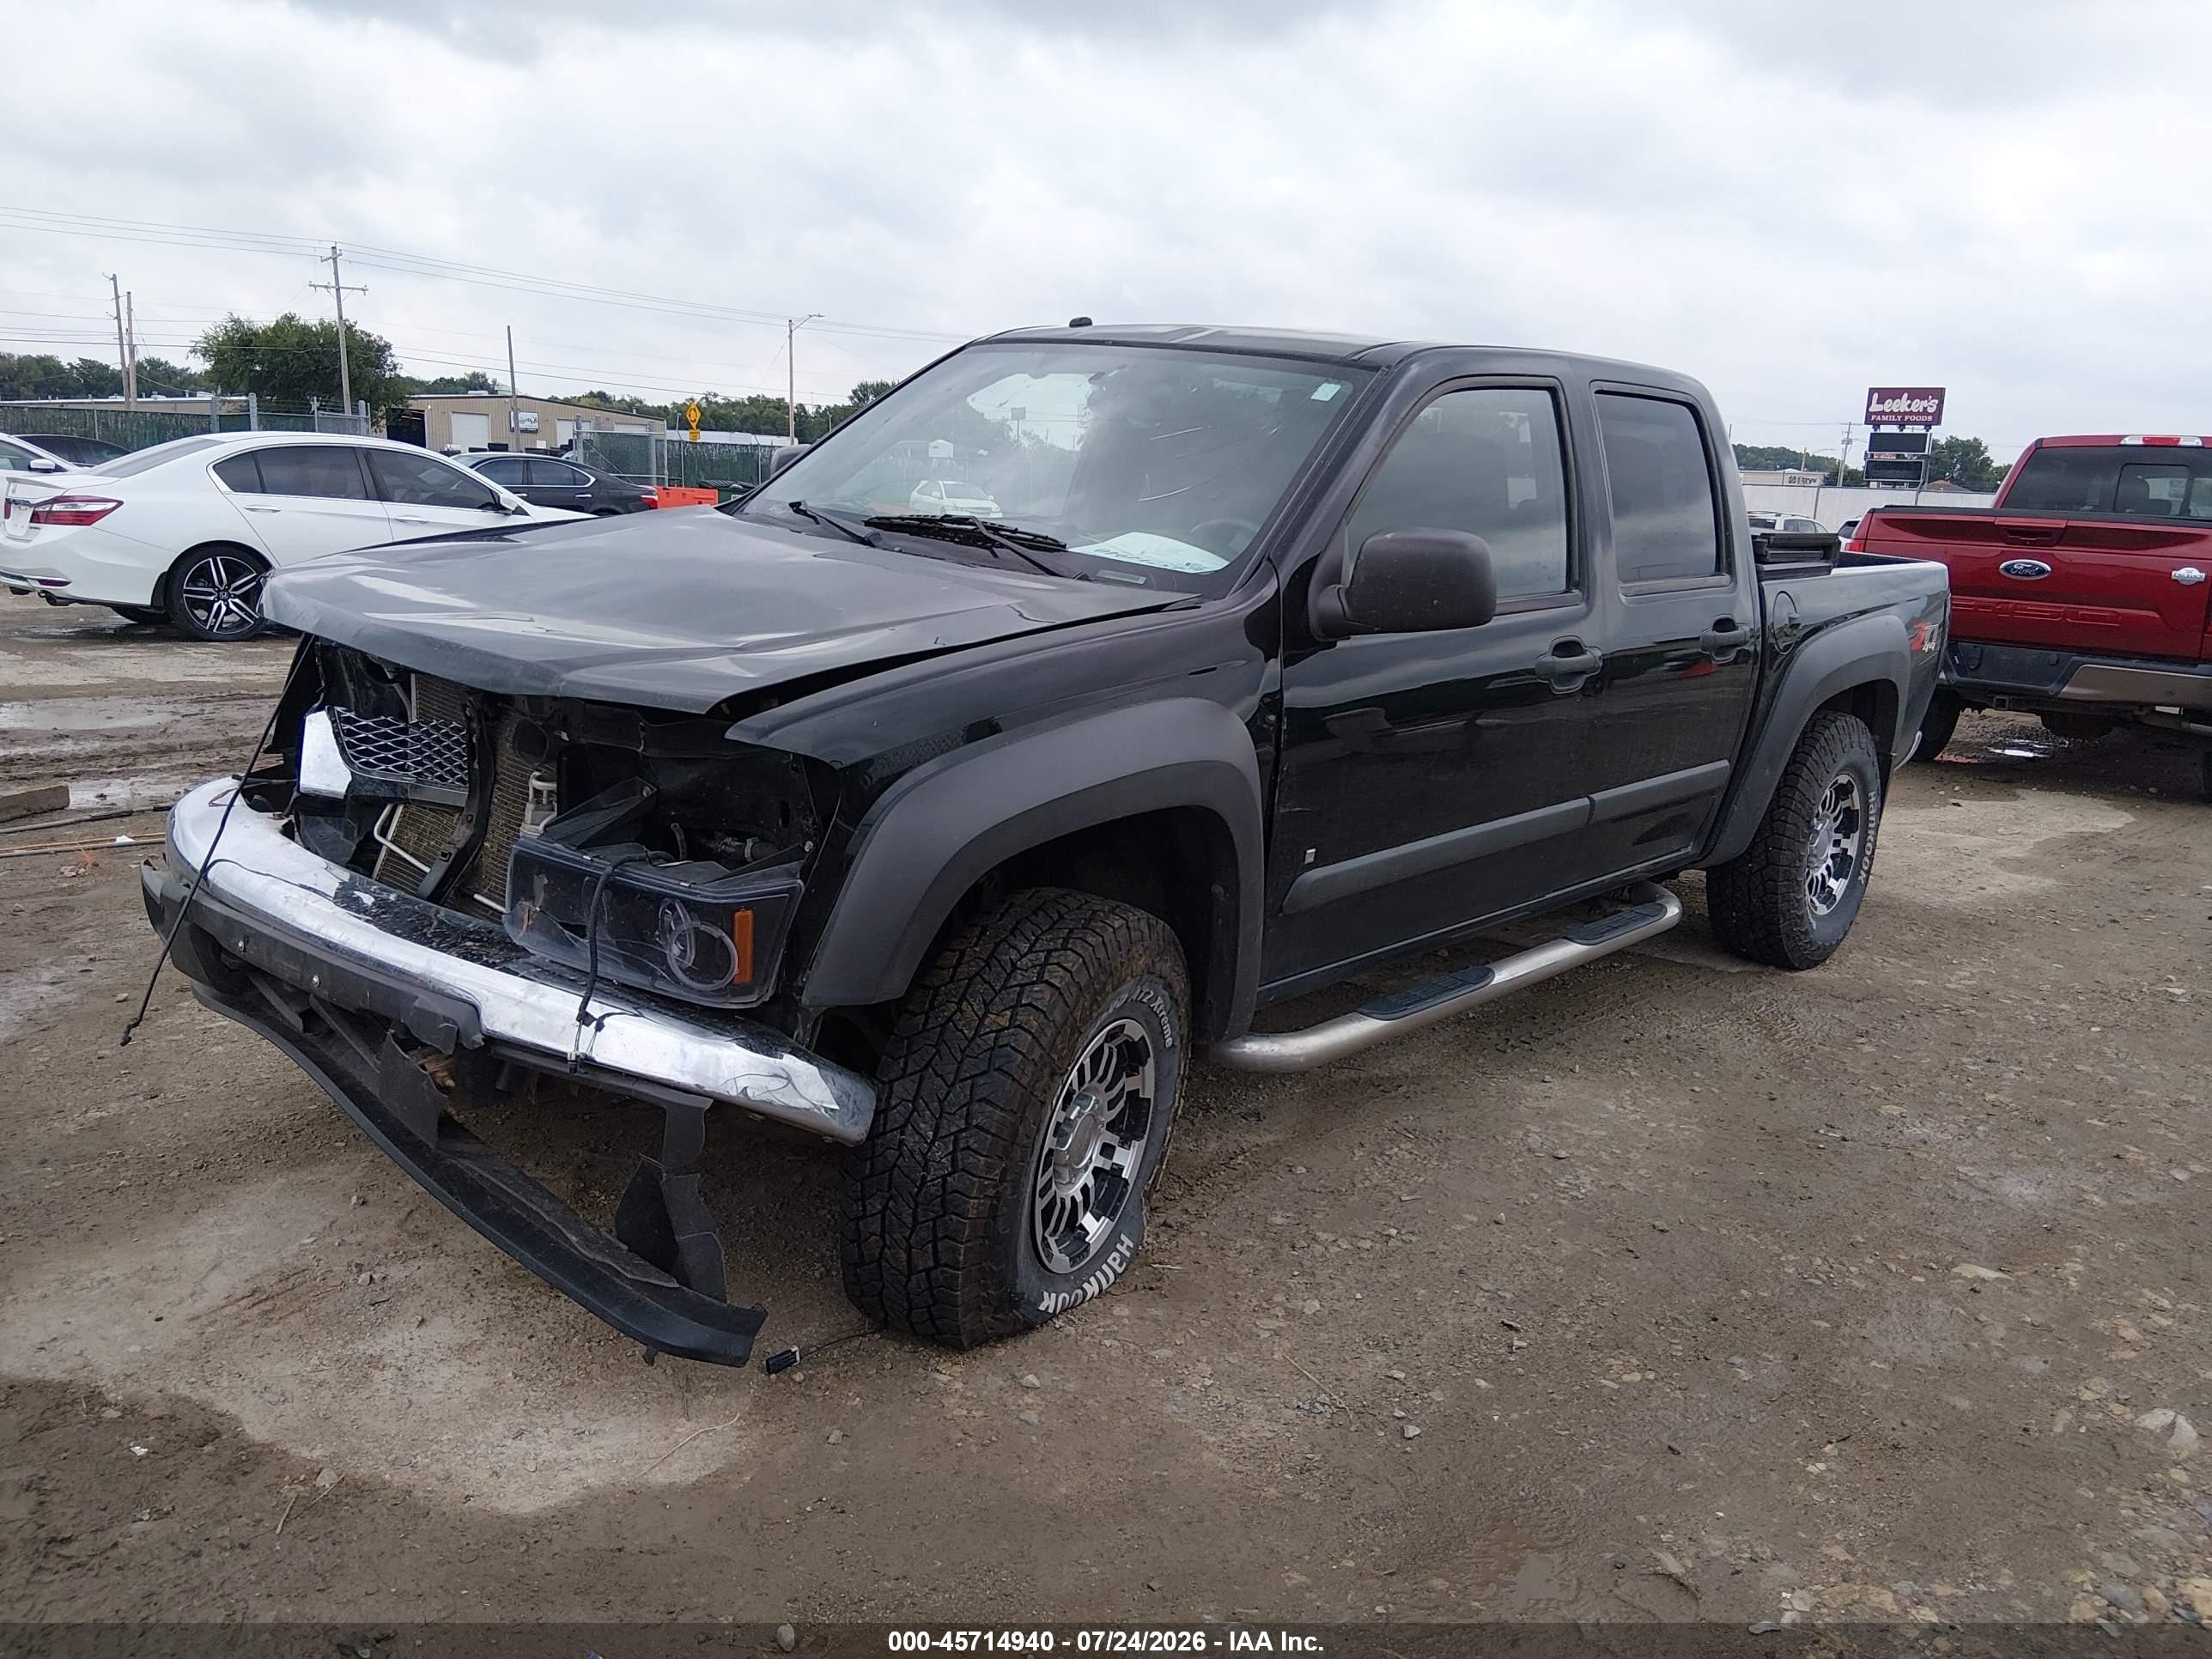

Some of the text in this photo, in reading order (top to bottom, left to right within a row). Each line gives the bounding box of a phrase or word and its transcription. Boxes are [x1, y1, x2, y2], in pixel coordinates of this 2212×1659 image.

[1869, 392, 1939, 413] Leeker's
[2010, 562, 2040, 575] Ford
[1150, 996, 1173, 1048] Xtreme
